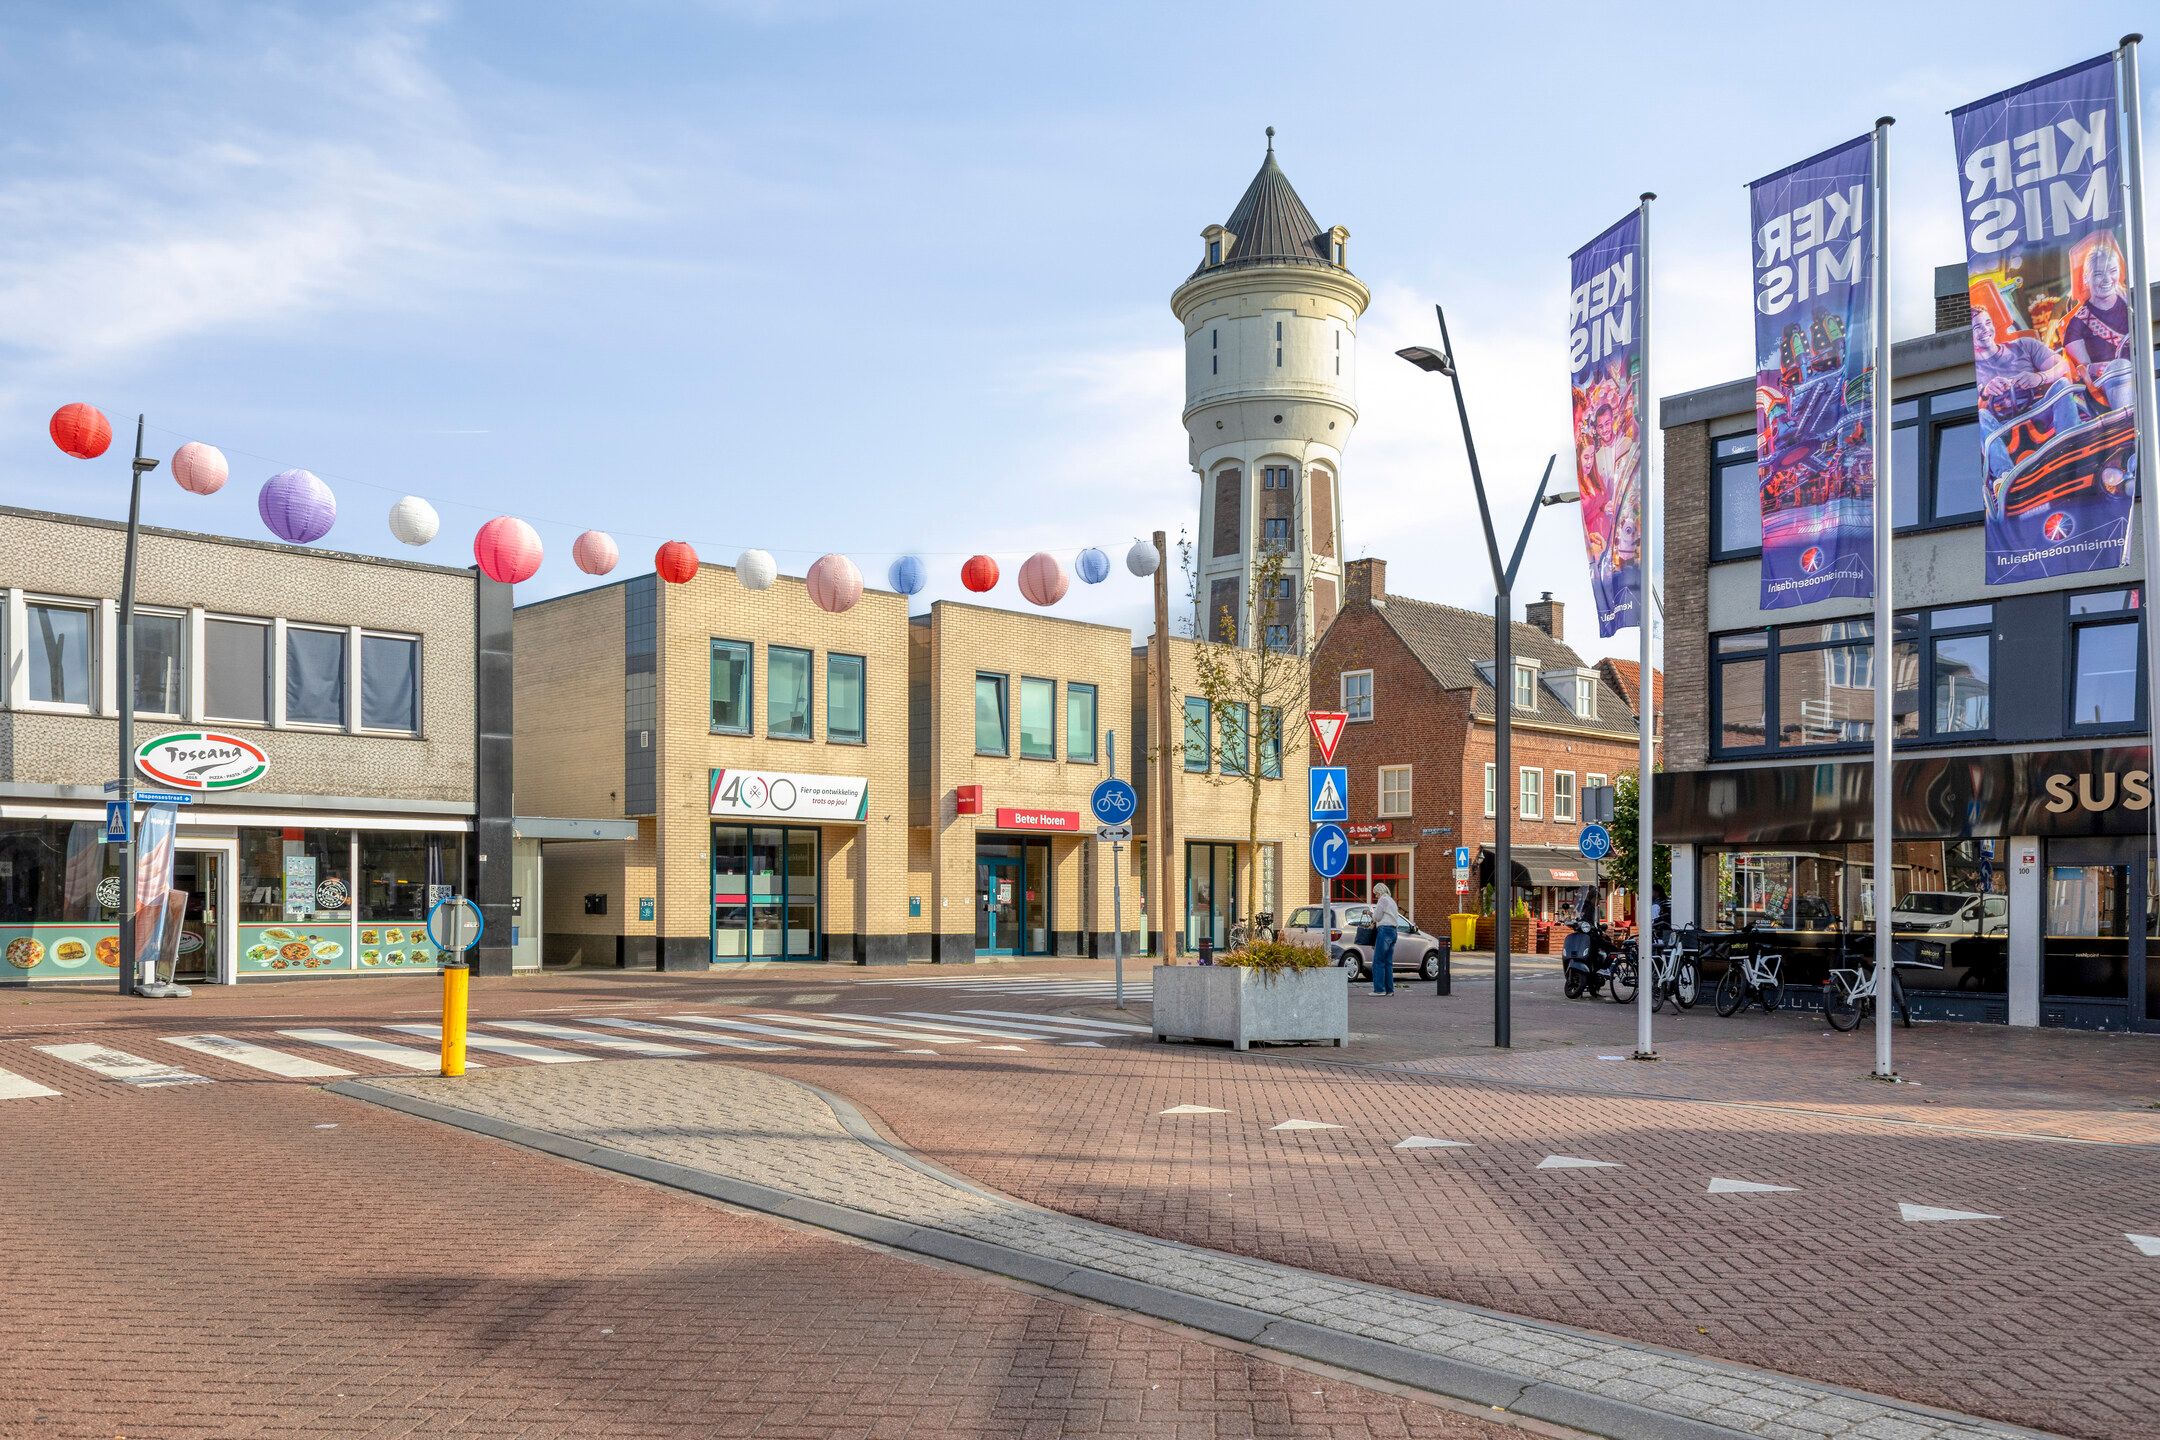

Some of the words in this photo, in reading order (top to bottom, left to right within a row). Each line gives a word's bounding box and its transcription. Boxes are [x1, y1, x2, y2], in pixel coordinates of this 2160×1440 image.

[164, 746, 242, 763] Toscana
[800, 786, 812, 794] Fier
[812, 788, 821, 796] op
[821, 787, 859, 797] ontwikkeling
[2045, 770, 2152, 813] SUS
[1015, 813, 1038, 824] Beter
[1040, 814, 1065, 826] Horen
